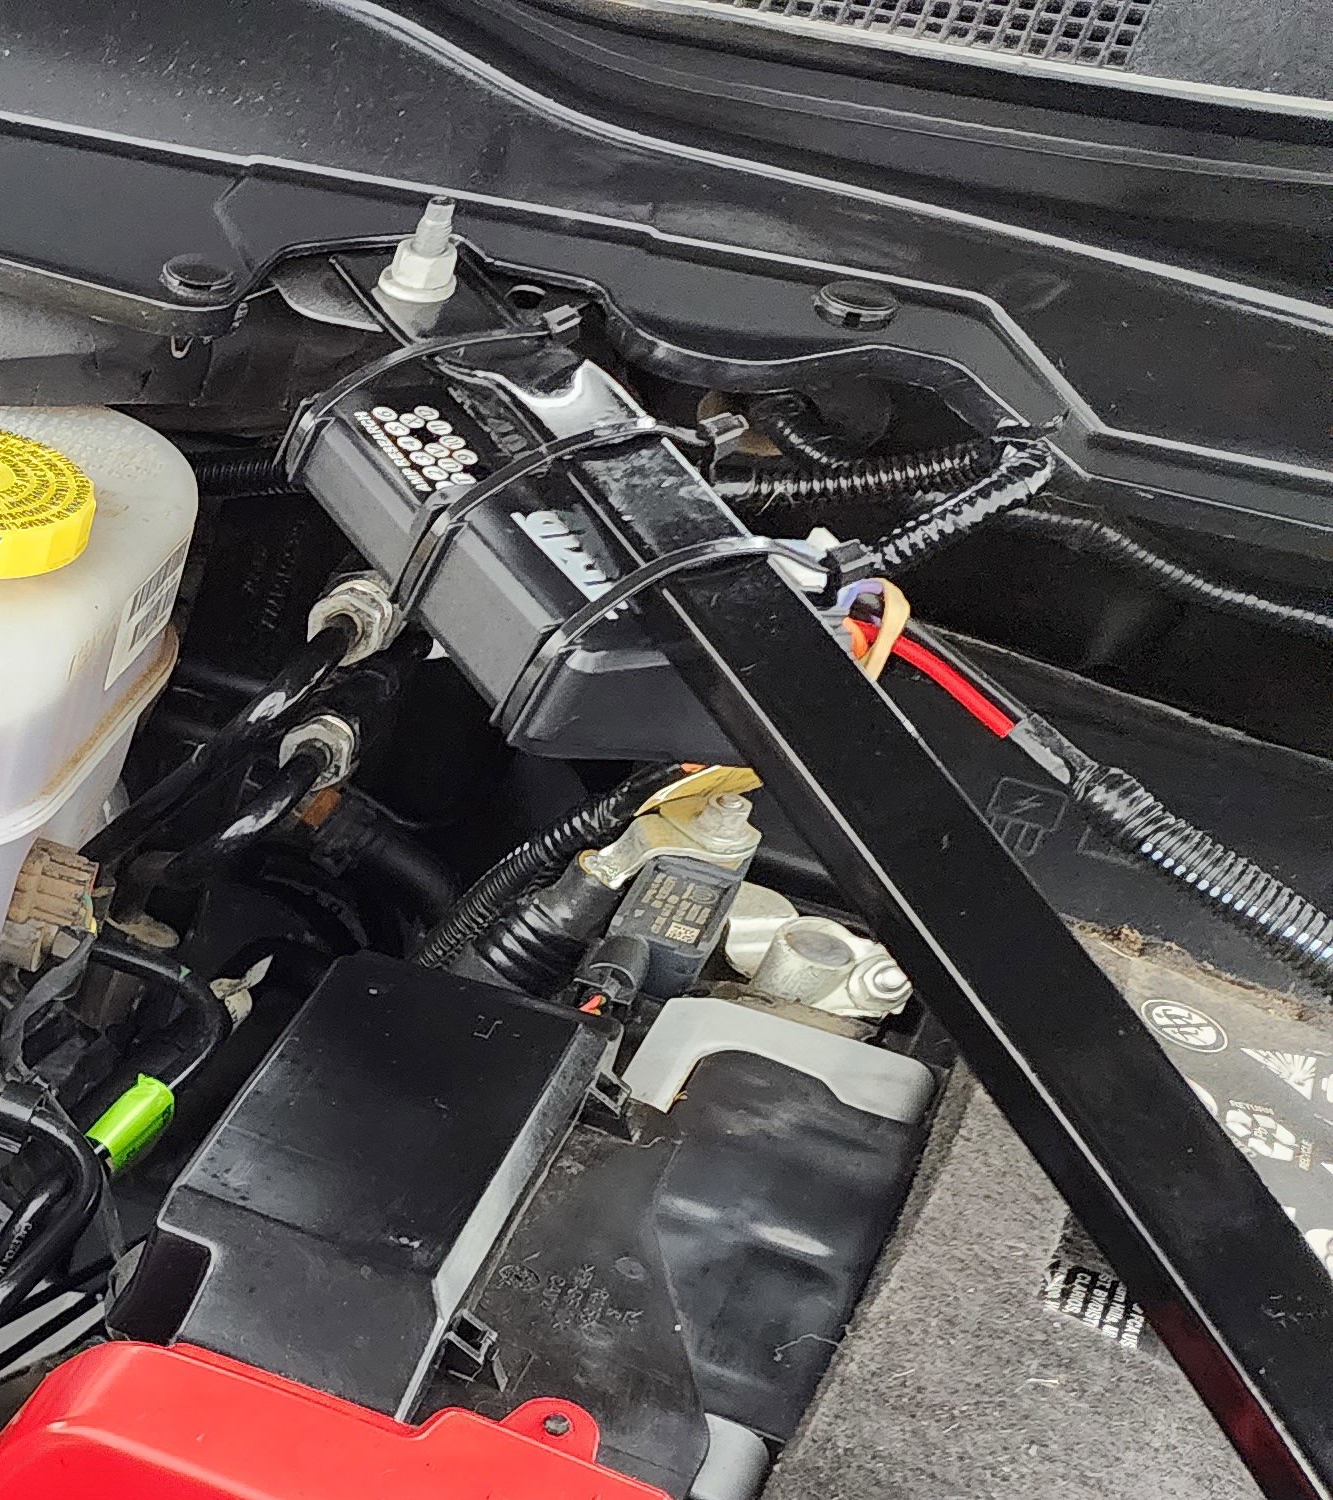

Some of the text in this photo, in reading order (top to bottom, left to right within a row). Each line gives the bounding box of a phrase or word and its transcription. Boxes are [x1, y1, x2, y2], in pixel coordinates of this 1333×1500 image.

[354, 411, 433, 492] AMP RESEARCH
[1119, 1313, 1145, 1350] FCA US
